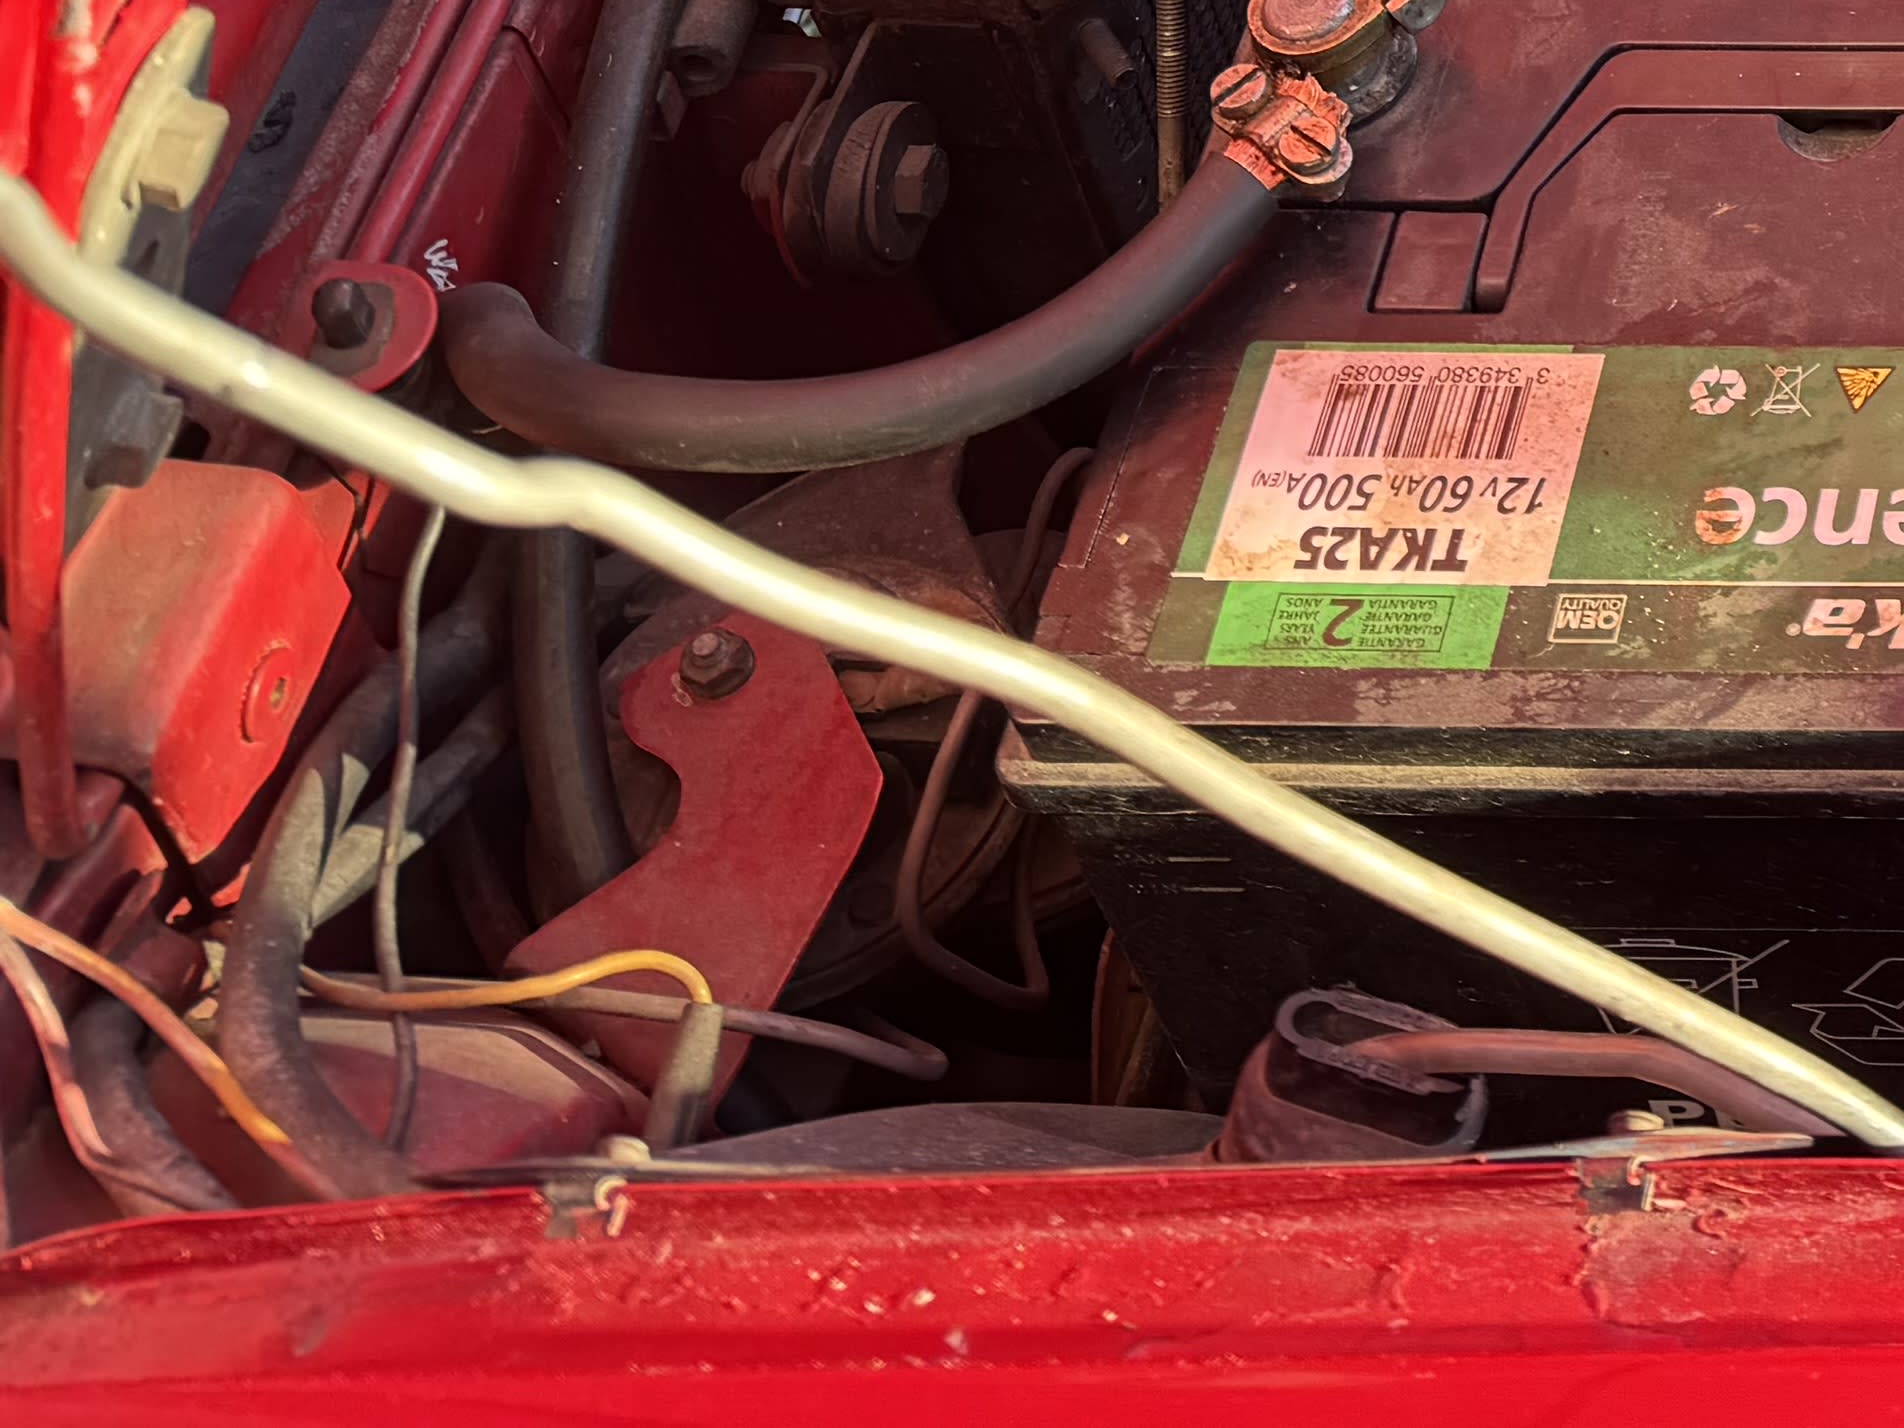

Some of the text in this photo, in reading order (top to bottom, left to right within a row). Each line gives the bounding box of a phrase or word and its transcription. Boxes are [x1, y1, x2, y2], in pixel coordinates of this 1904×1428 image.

[1339, 363, 1549, 383] 3 349380 560085
[1389, 472, 1473, 512] 60Ah
[1291, 525, 1467, 572] TKA25
[1321, 597, 1363, 646] 2
[1559, 596, 1622, 609] QUALITY
